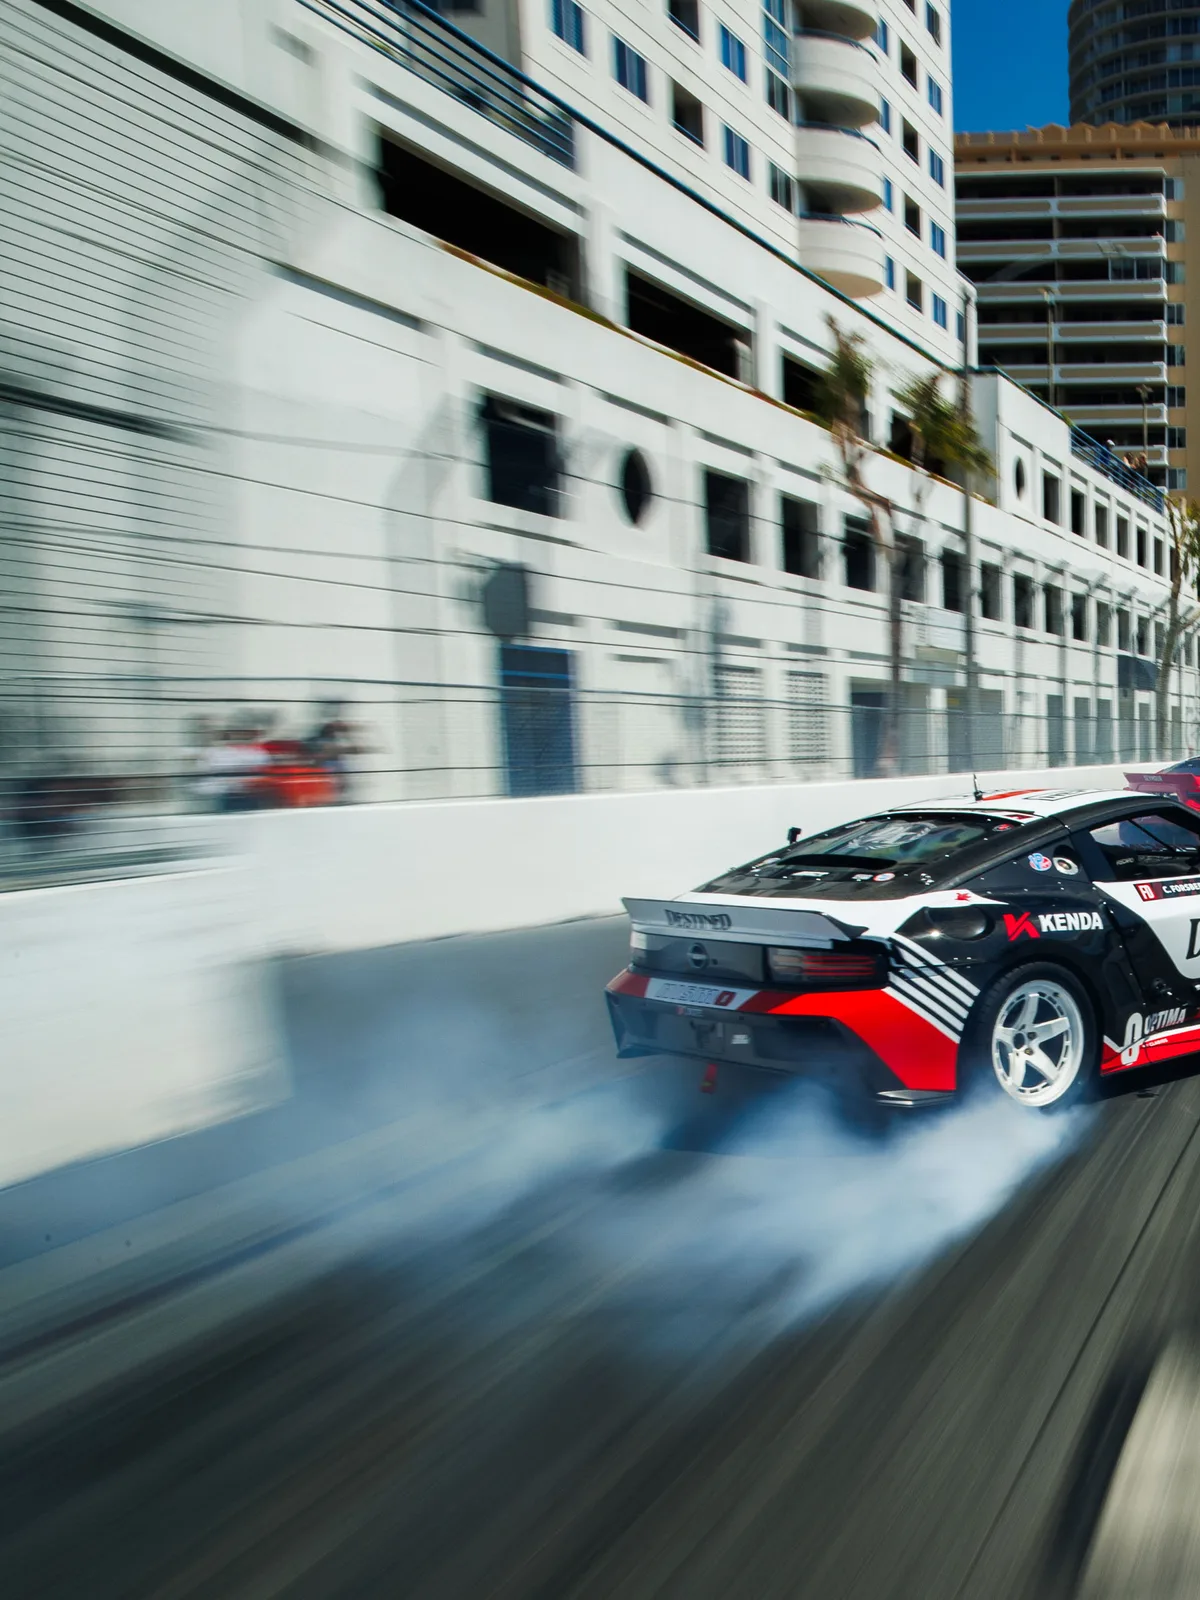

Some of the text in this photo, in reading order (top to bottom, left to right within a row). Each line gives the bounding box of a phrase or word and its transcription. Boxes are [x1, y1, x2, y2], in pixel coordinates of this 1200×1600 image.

[663, 908, 732, 931] DESTINED
[1038, 911, 1104, 932] KENDA
[1144, 1007, 1187, 1035] OPTIMA
